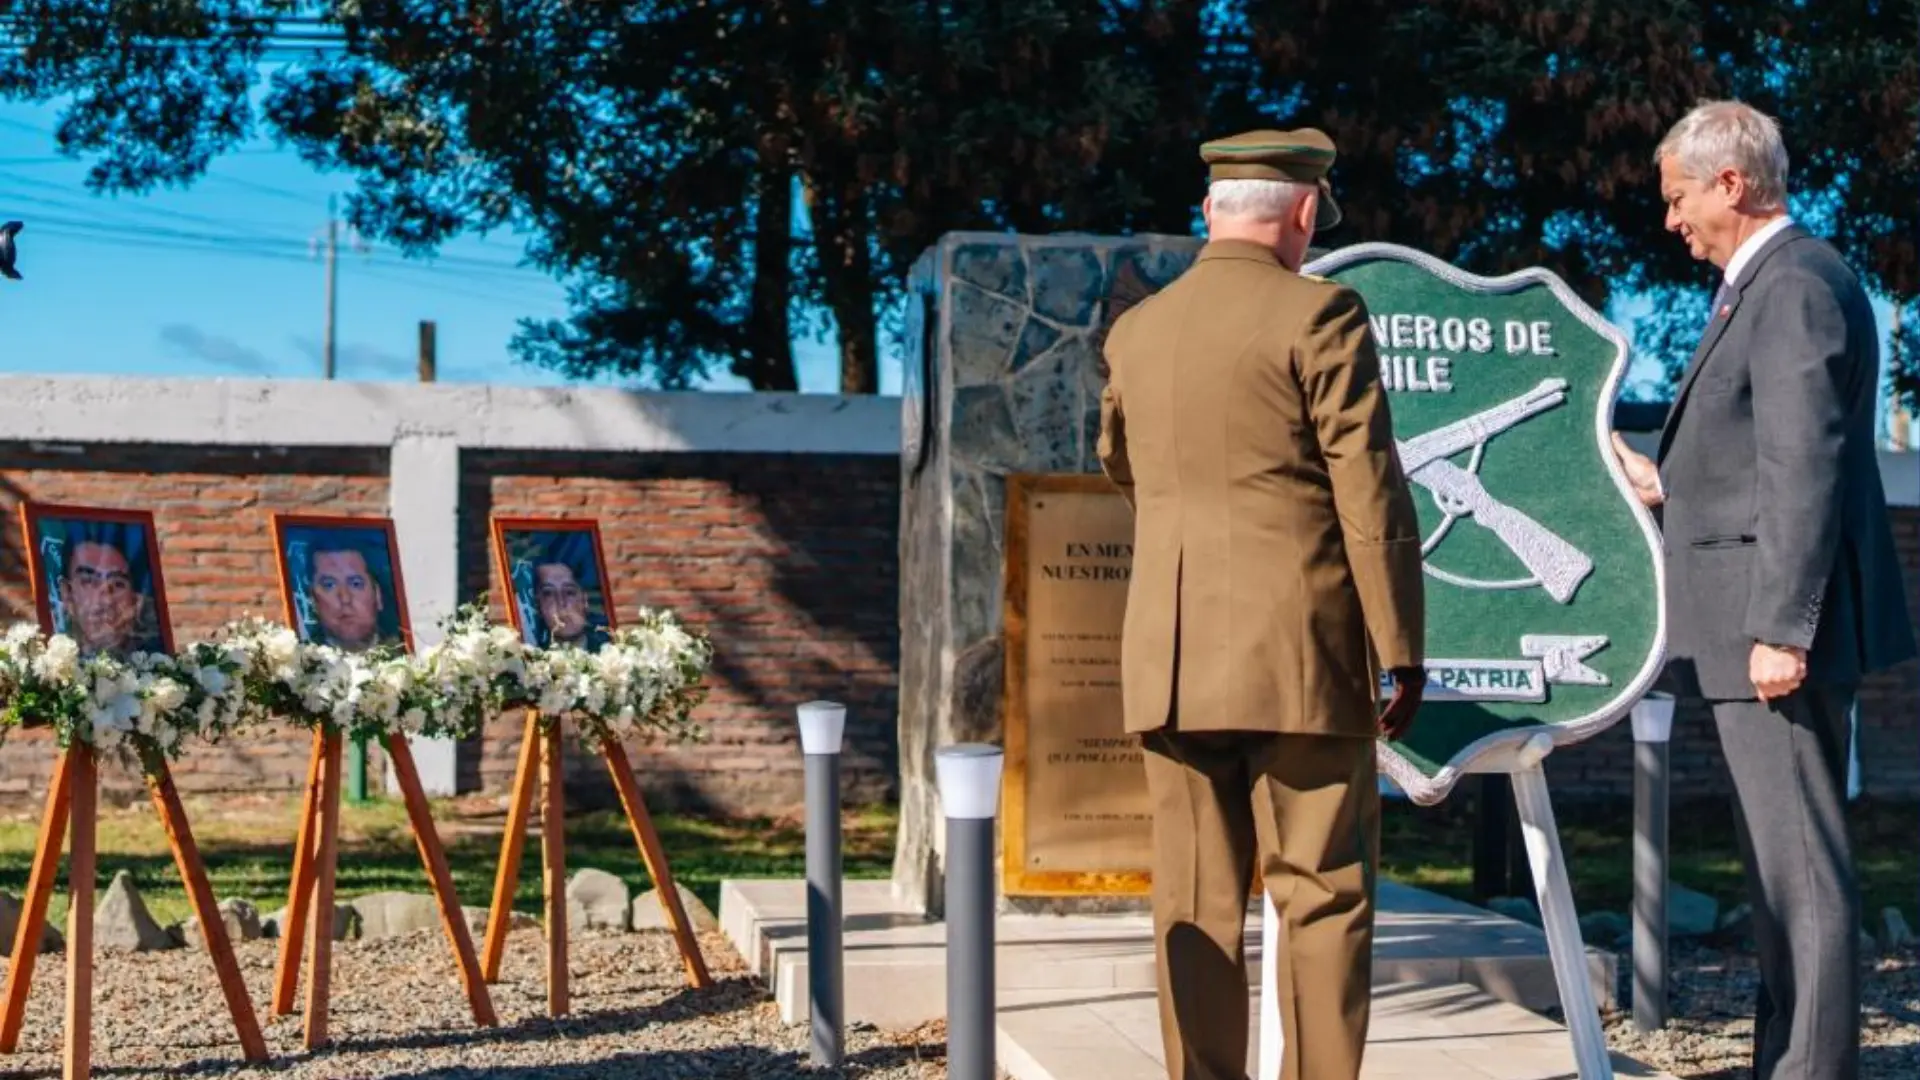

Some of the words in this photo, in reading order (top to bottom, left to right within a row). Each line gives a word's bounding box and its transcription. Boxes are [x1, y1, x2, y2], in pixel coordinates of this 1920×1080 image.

[1504, 320, 1554, 355] DE
[1041, 565, 1131, 580] NUESTRO
[1440, 668, 1533, 689] PATRIA
